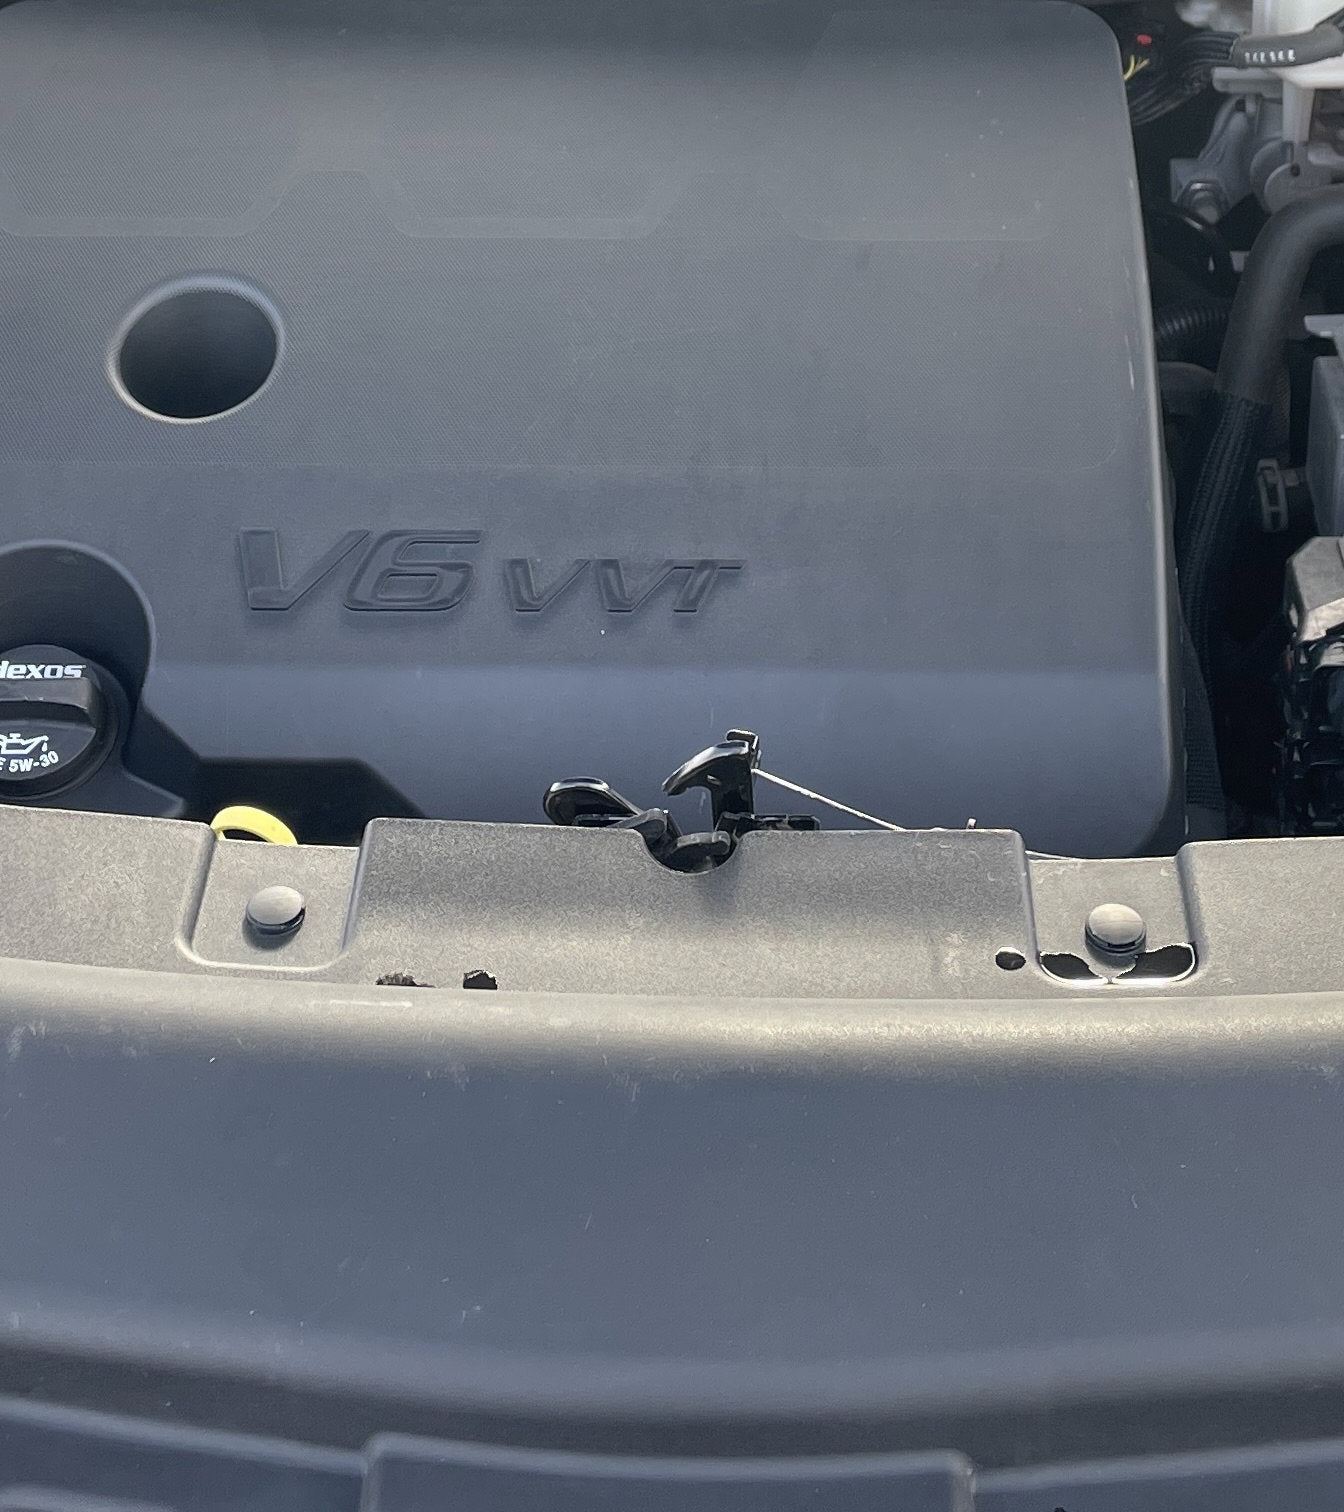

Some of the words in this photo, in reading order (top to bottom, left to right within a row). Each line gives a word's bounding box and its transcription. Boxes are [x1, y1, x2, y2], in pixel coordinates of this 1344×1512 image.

[235, 528, 483, 611] V6
[504, 558, 747, 612] VVT
[8, 750, 59, 773] 5W-30
